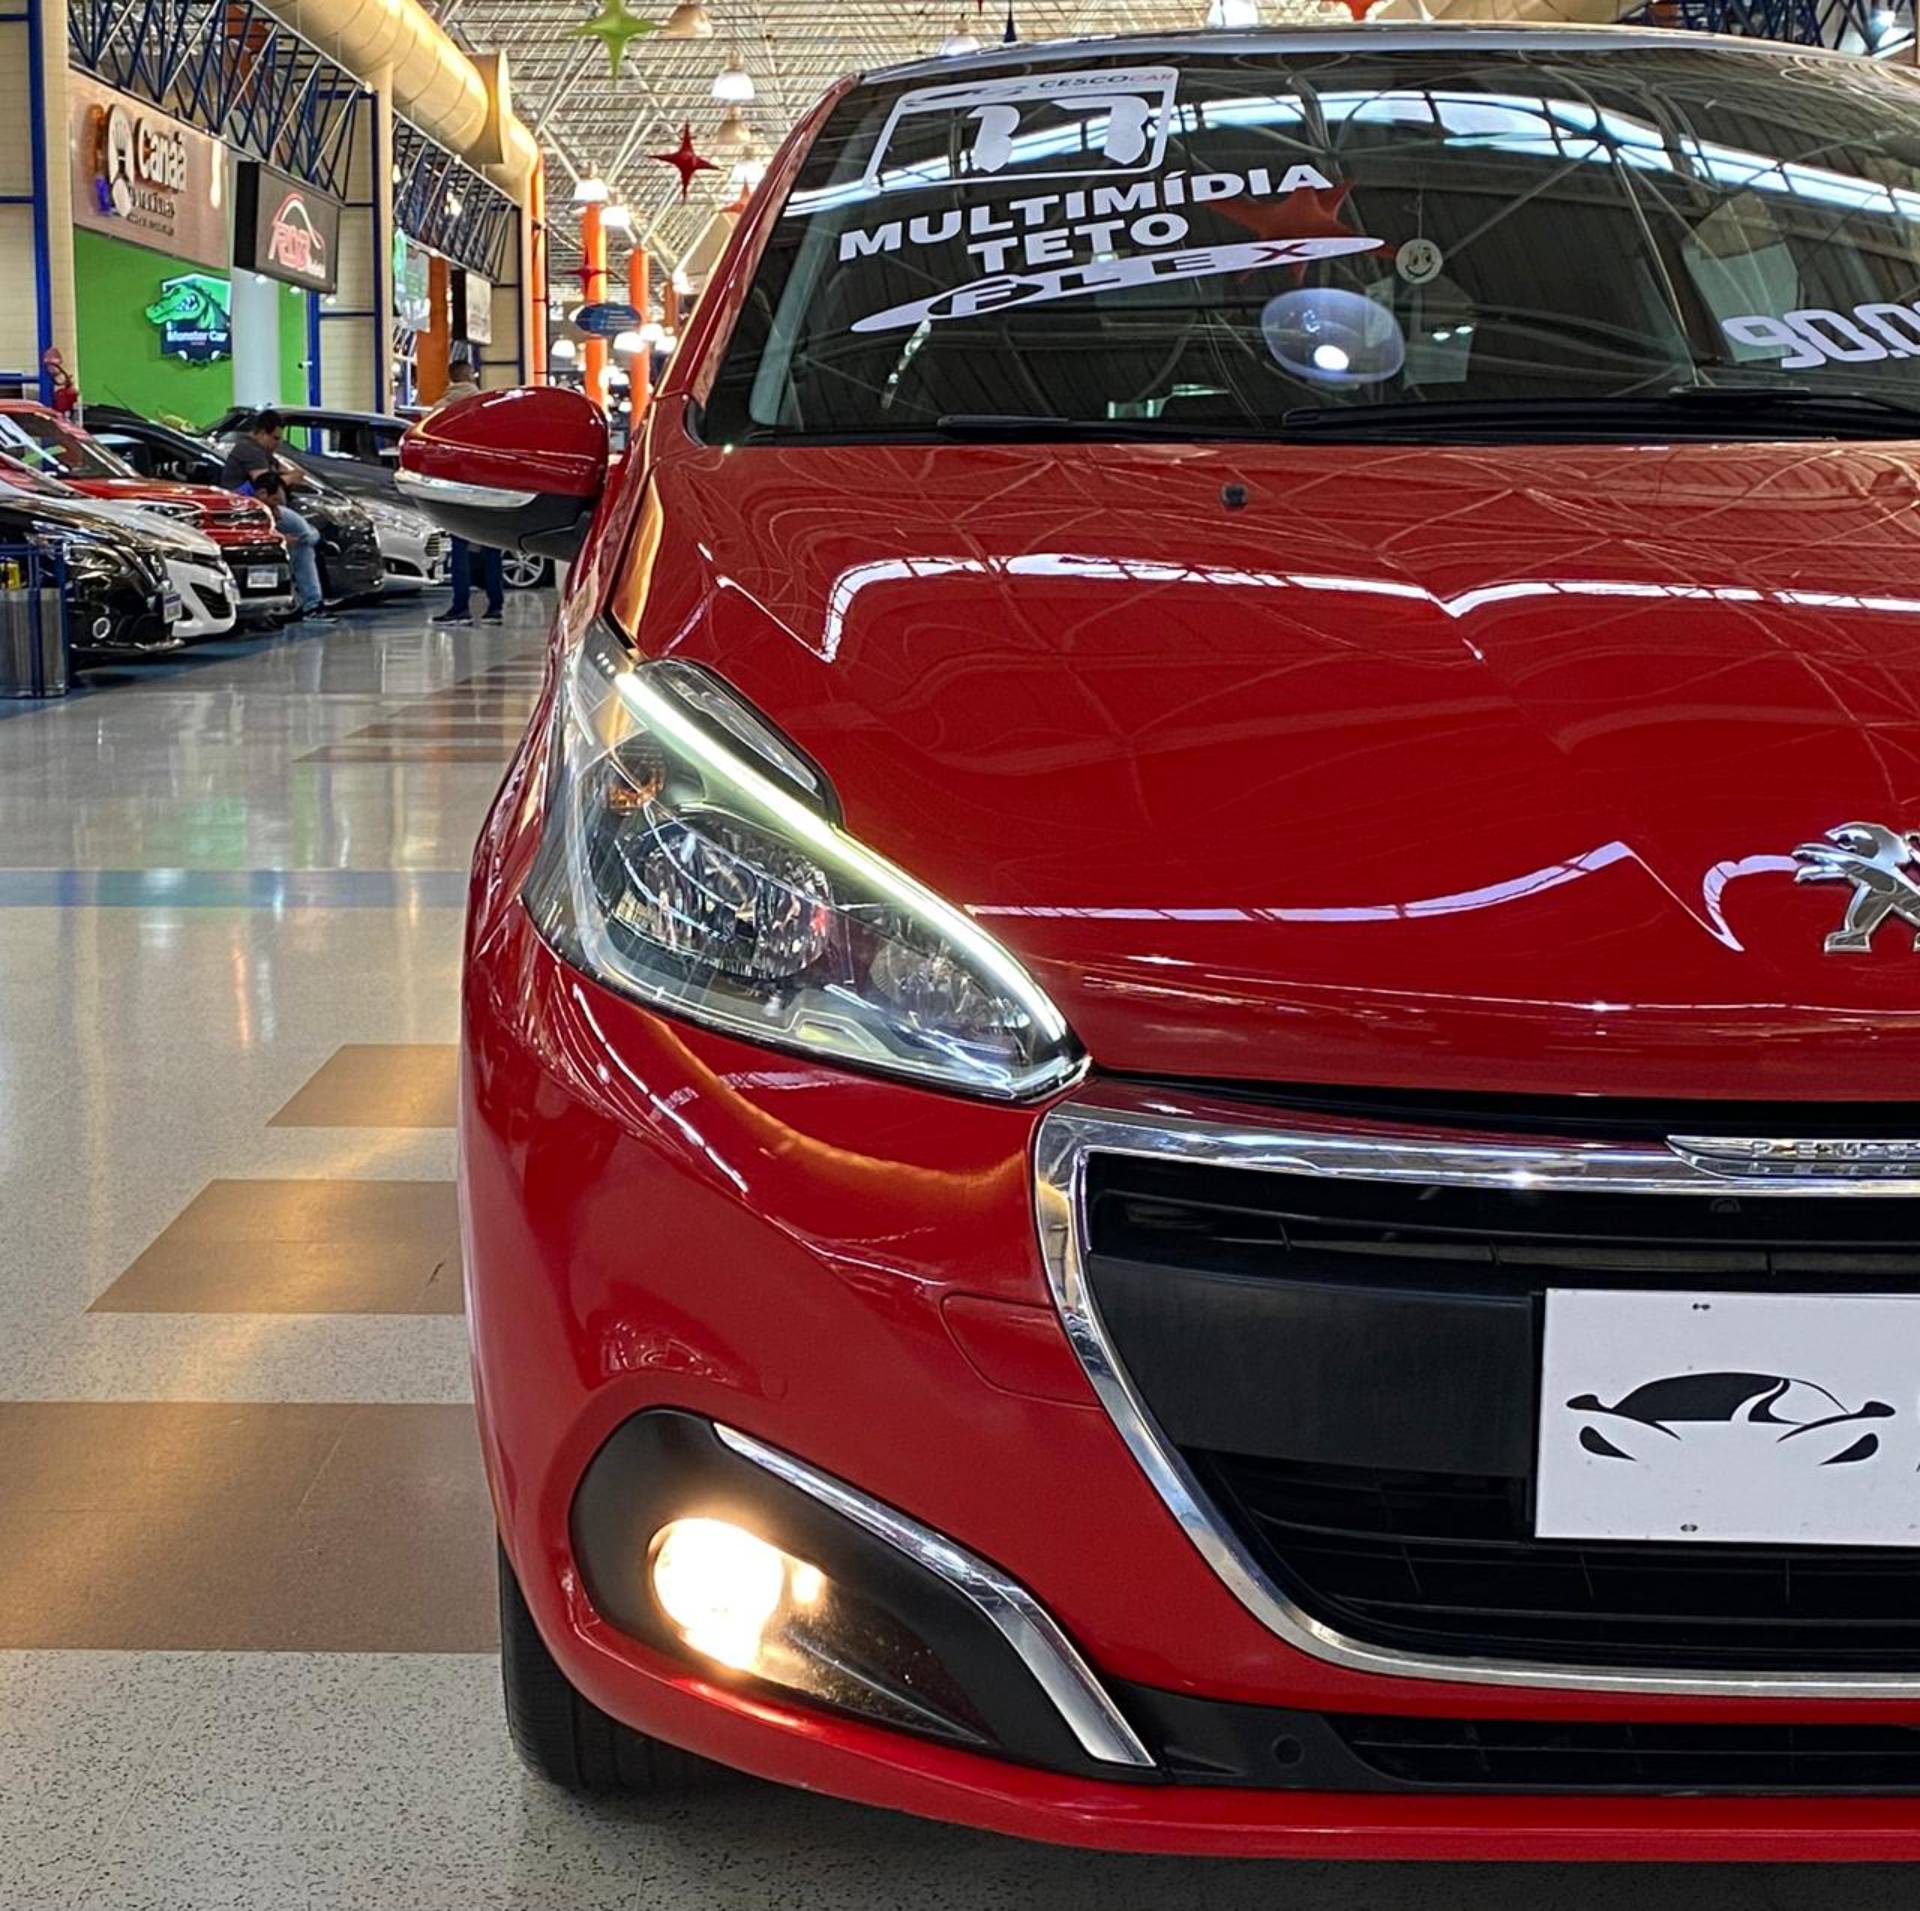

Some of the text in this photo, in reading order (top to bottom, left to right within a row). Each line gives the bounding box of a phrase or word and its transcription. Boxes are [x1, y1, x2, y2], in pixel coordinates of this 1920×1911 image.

[1039, 74, 1174, 89] CESCOCAR
[838, 162, 1334, 262] MULTIMÍDIA
[966, 211, 1189, 274] TETO
[948, 241, 1310, 317] FLEX
[209, 330, 228, 342] Car
[1721, 301, 1920, 369] 90.0
